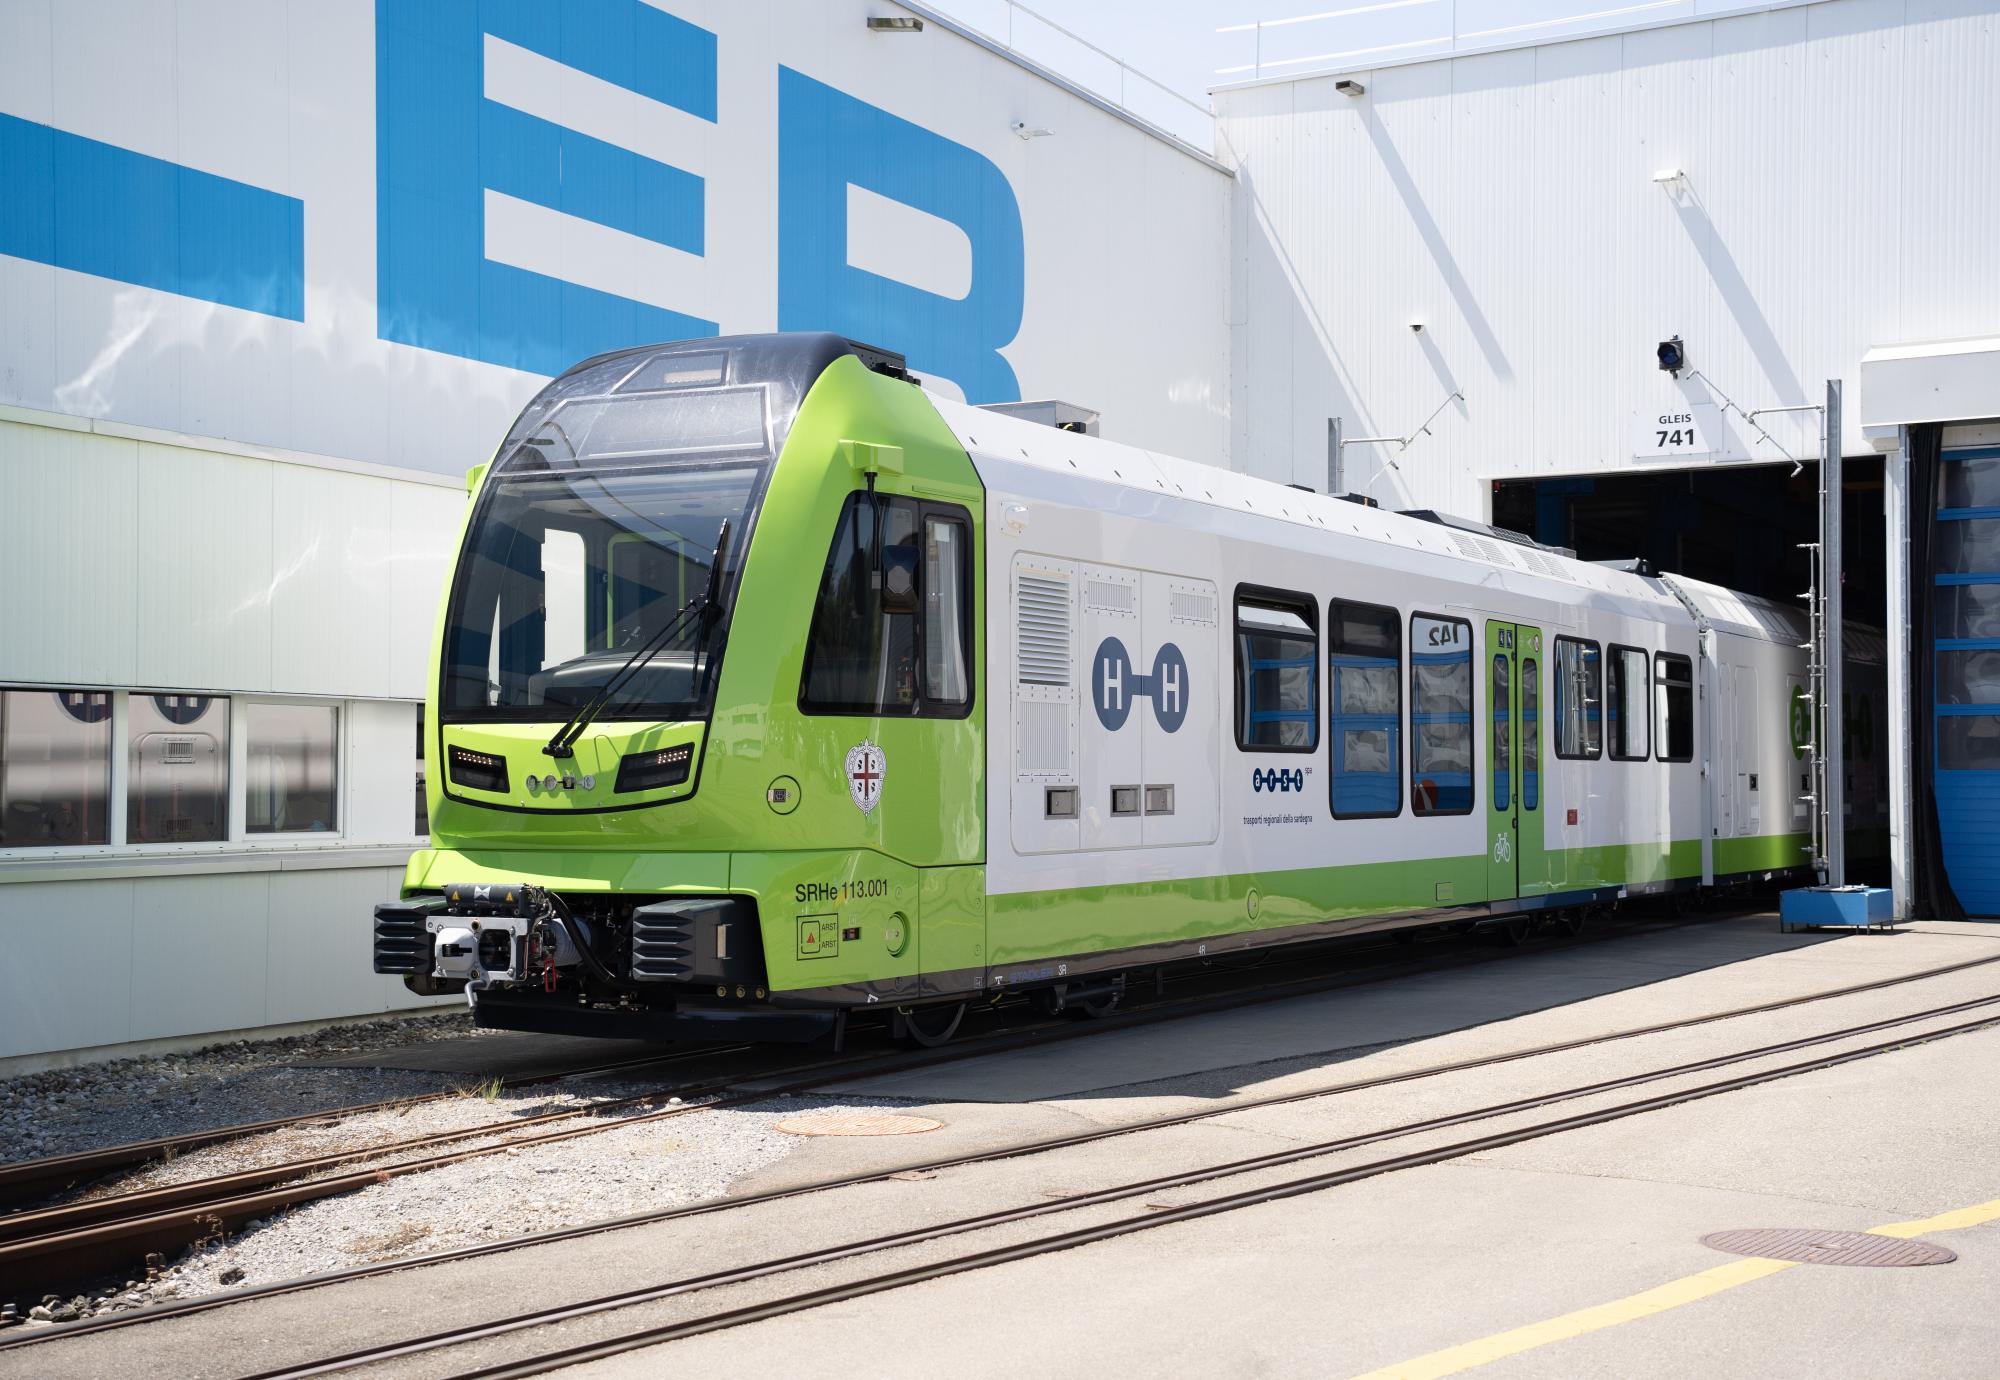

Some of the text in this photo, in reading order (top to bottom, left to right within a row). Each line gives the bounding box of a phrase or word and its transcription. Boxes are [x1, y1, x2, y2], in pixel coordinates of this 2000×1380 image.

[1658, 413, 1692, 424] GLEIS
[1656, 428, 1694, 447] 741
[1253, 768, 1303, 792] arst
[795, 878, 888, 903] SRHe 113.001
[821, 922, 837, 931] ARST
[821, 940, 837, 949] ARST
